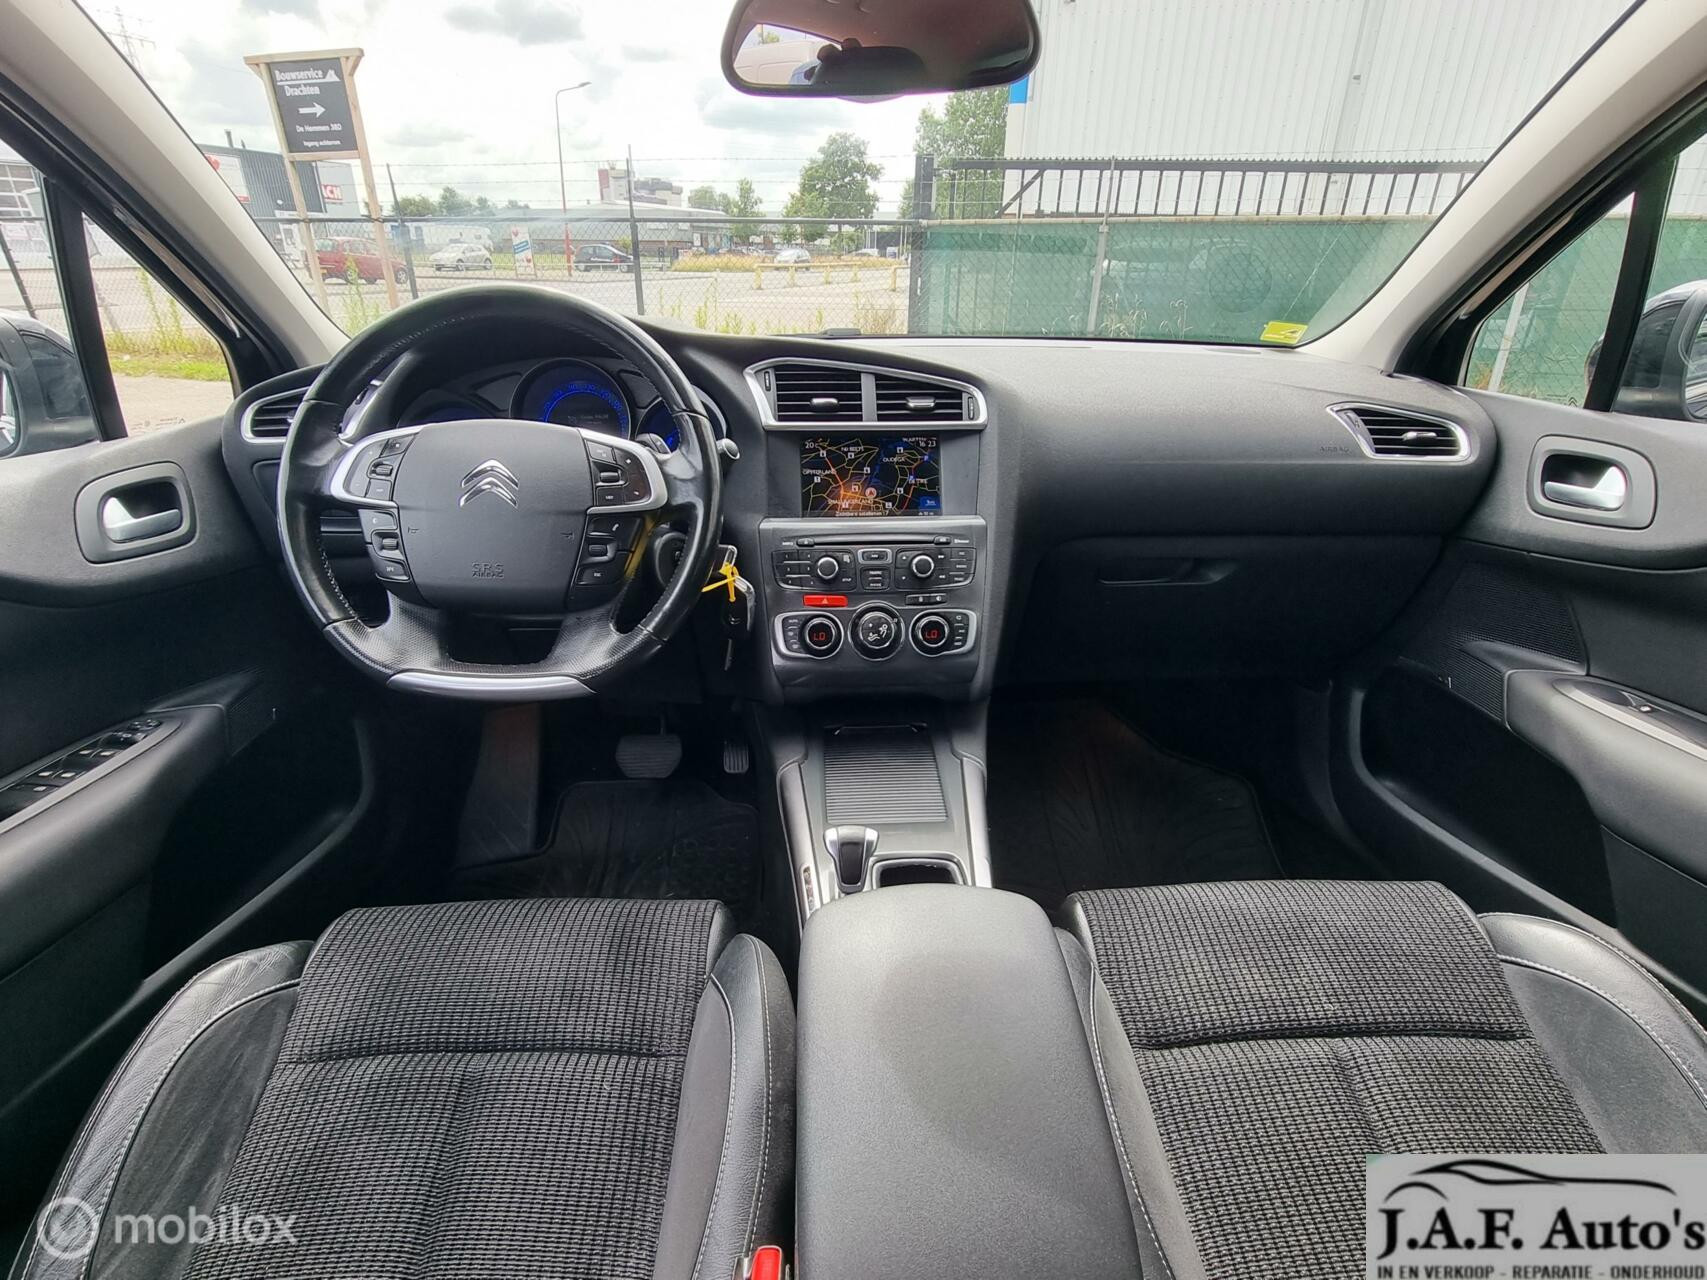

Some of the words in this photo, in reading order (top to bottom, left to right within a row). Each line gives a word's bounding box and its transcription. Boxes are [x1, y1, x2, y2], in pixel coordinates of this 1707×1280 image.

[274, 67, 323, 81] Bouwservice
[284, 84, 320, 96] Drachten
[295, 124, 304, 132] De
